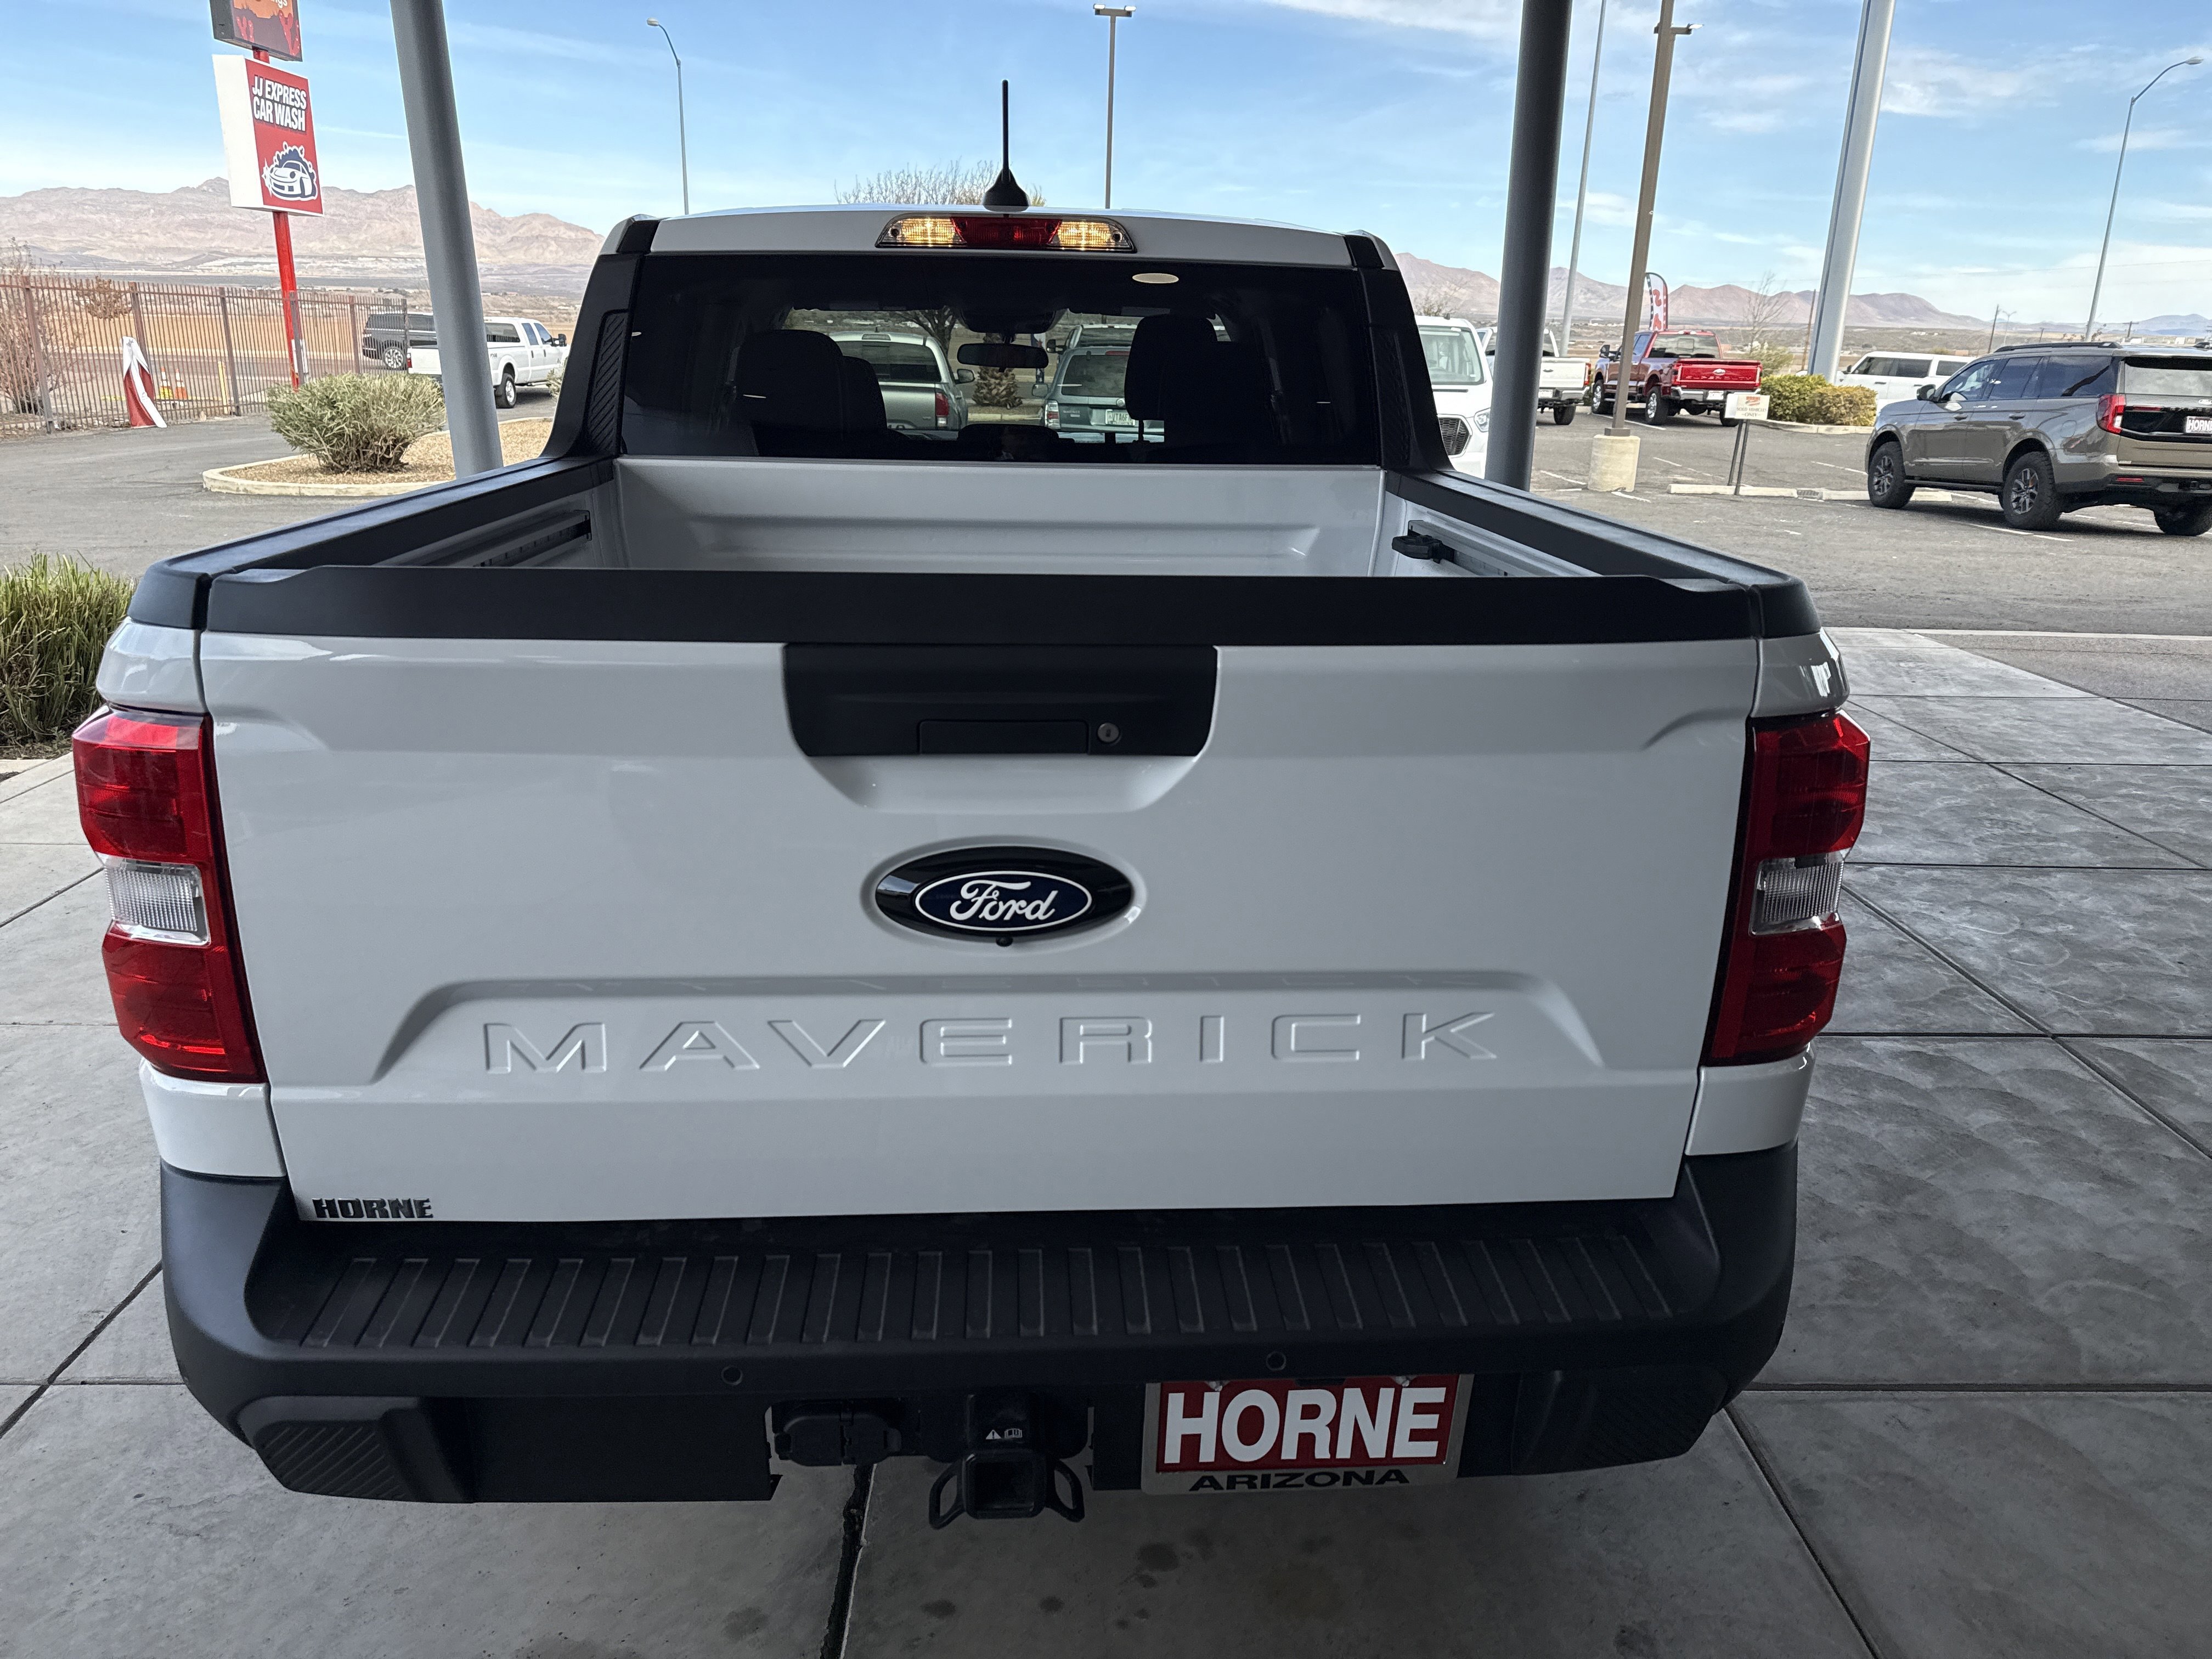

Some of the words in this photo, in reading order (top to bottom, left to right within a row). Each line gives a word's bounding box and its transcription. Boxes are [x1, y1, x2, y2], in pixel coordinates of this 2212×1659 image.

[252, 76, 263, 97] JJ
[265, 79, 307, 110] EXPRESS
[253, 96, 274, 123] CAR
[274, 102, 306, 132] WASH
[950, 879, 1058, 921] Ford
[483, 1012, 1497, 1074] MAVERICK
[312, 1198, 433, 1218] HORNE
[1164, 1387, 1447, 1464] HORNE
[1188, 1469, 1410, 1492] ARIZONA
